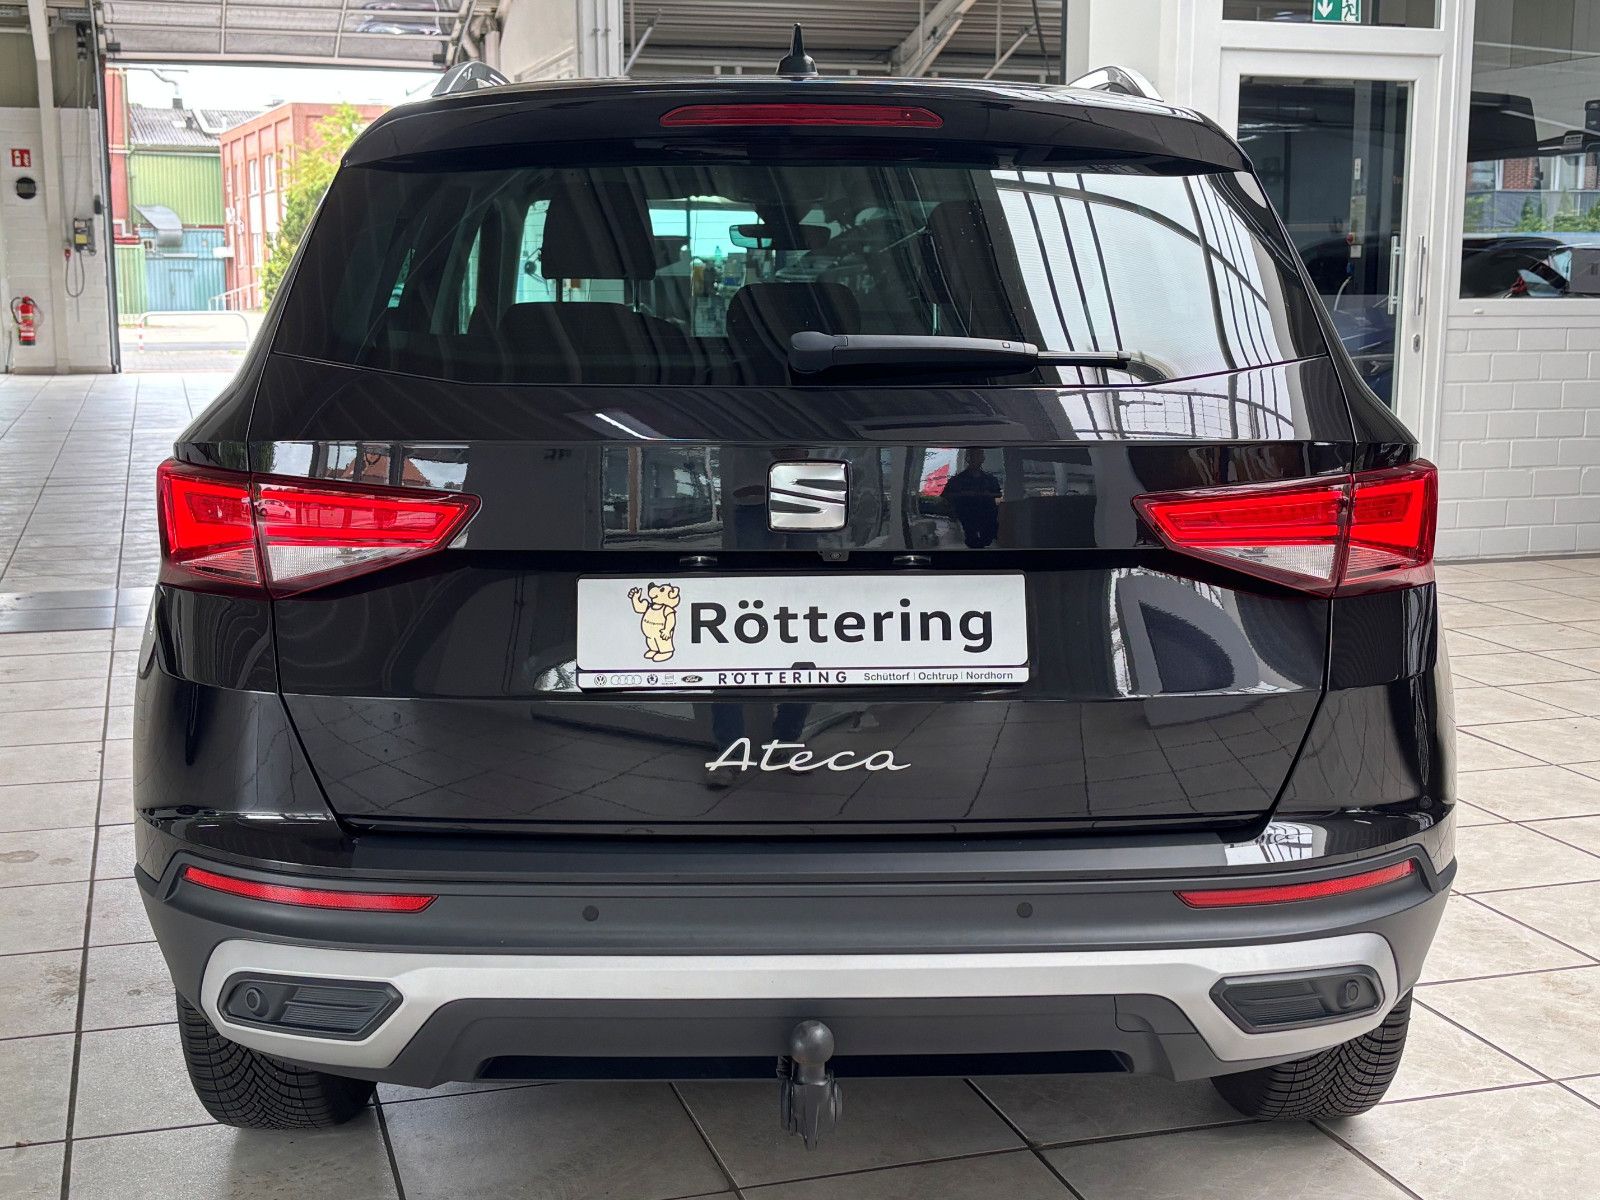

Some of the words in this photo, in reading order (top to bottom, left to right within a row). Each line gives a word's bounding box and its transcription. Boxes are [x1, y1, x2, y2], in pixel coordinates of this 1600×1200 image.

[690, 598, 993, 654] Röttering
[717, 670, 848, 685] RÖTTERING
[863, 671, 911, 682] Schüttorf
[917, 671, 959, 683] Ochtrup
[965, 670, 1014, 681] Nordhorn
[704, 737, 912, 771] Ateca
